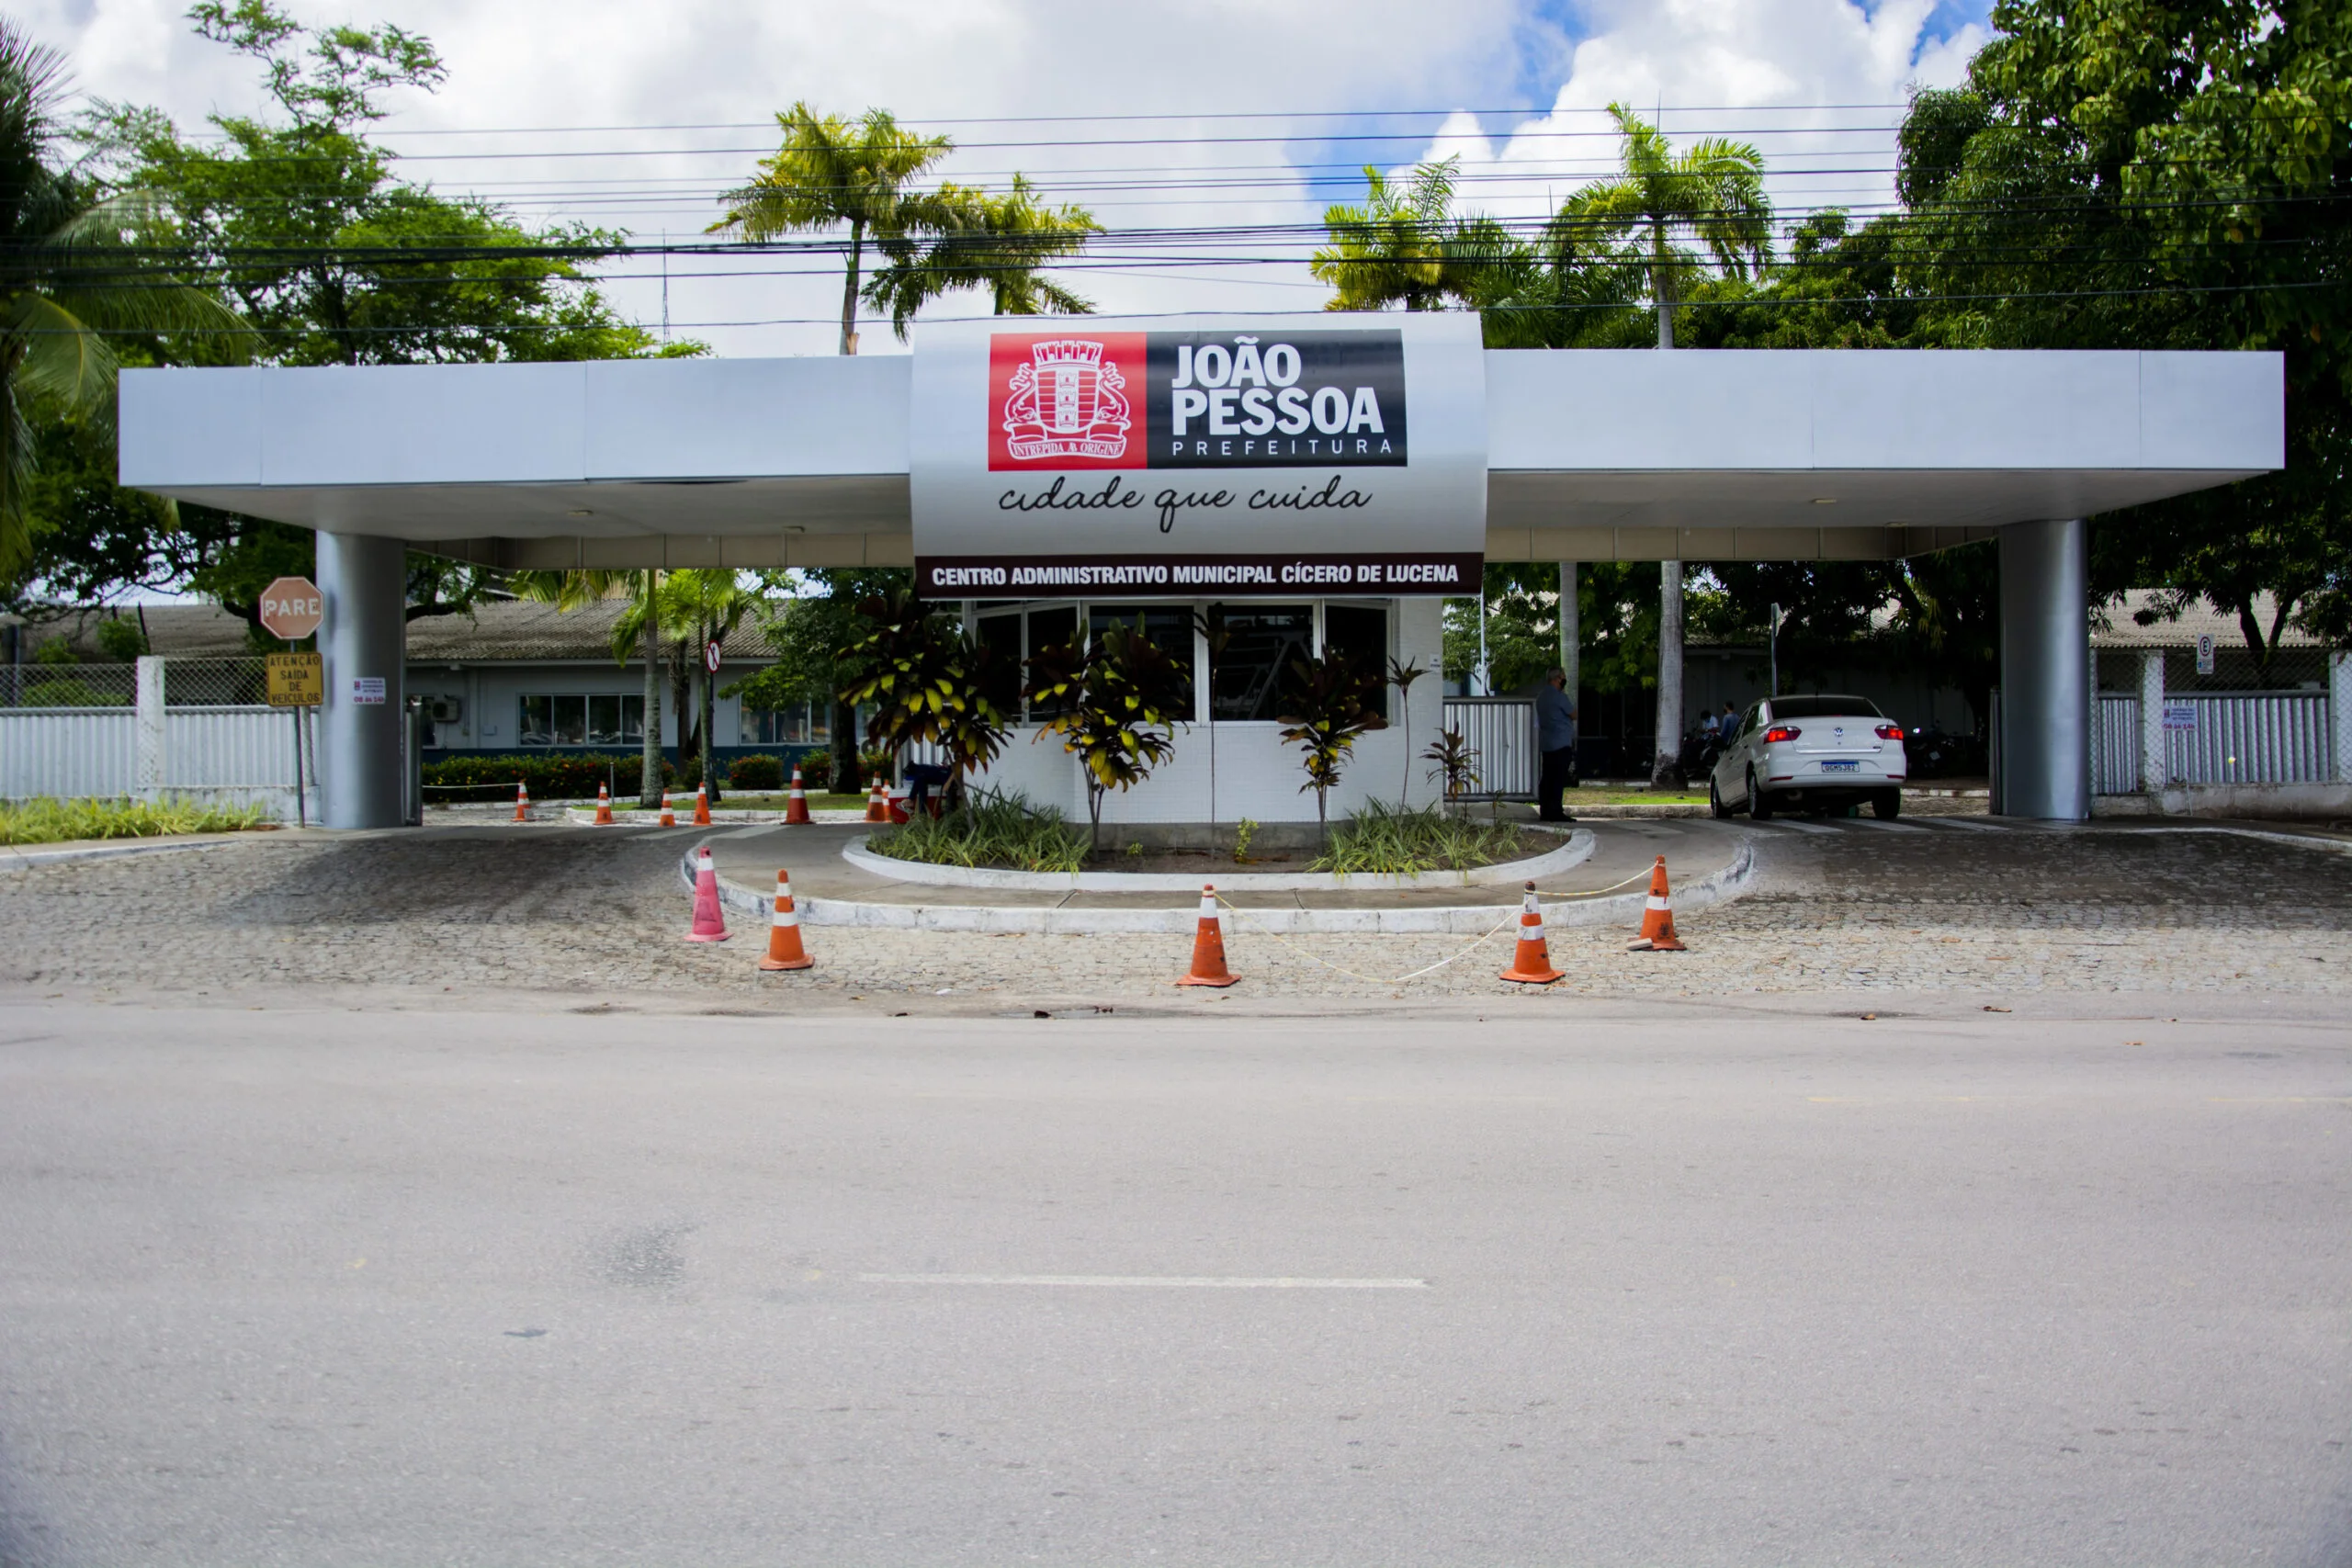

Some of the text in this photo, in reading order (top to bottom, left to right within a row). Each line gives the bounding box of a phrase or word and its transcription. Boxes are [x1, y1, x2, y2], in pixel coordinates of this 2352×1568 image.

[1171, 336, 1302, 389] JOÃO
[1171, 386, 1385, 436] PESSOA
[1012, 441, 1064, 457] INTREPIDA
[1080, 442, 1121, 457] ORIGINE
[1172, 439, 1392, 456] PREFEITURA
[999, 475, 1374, 533] cidade que cuida
[932, 561, 1459, 586] CENTRO ADMINISTRATIVO MUNICIPAL CÍCERO DE LUCENA
[265, 598, 320, 616] PARE
[2202, 640, 2208, 652] E
[269, 655, 320, 667] ATENÇÃO
[280, 669, 309, 680] SAÍDA
[289, 682, 302, 692] DE
[270, 693, 320, 704] VEÍCULOS
